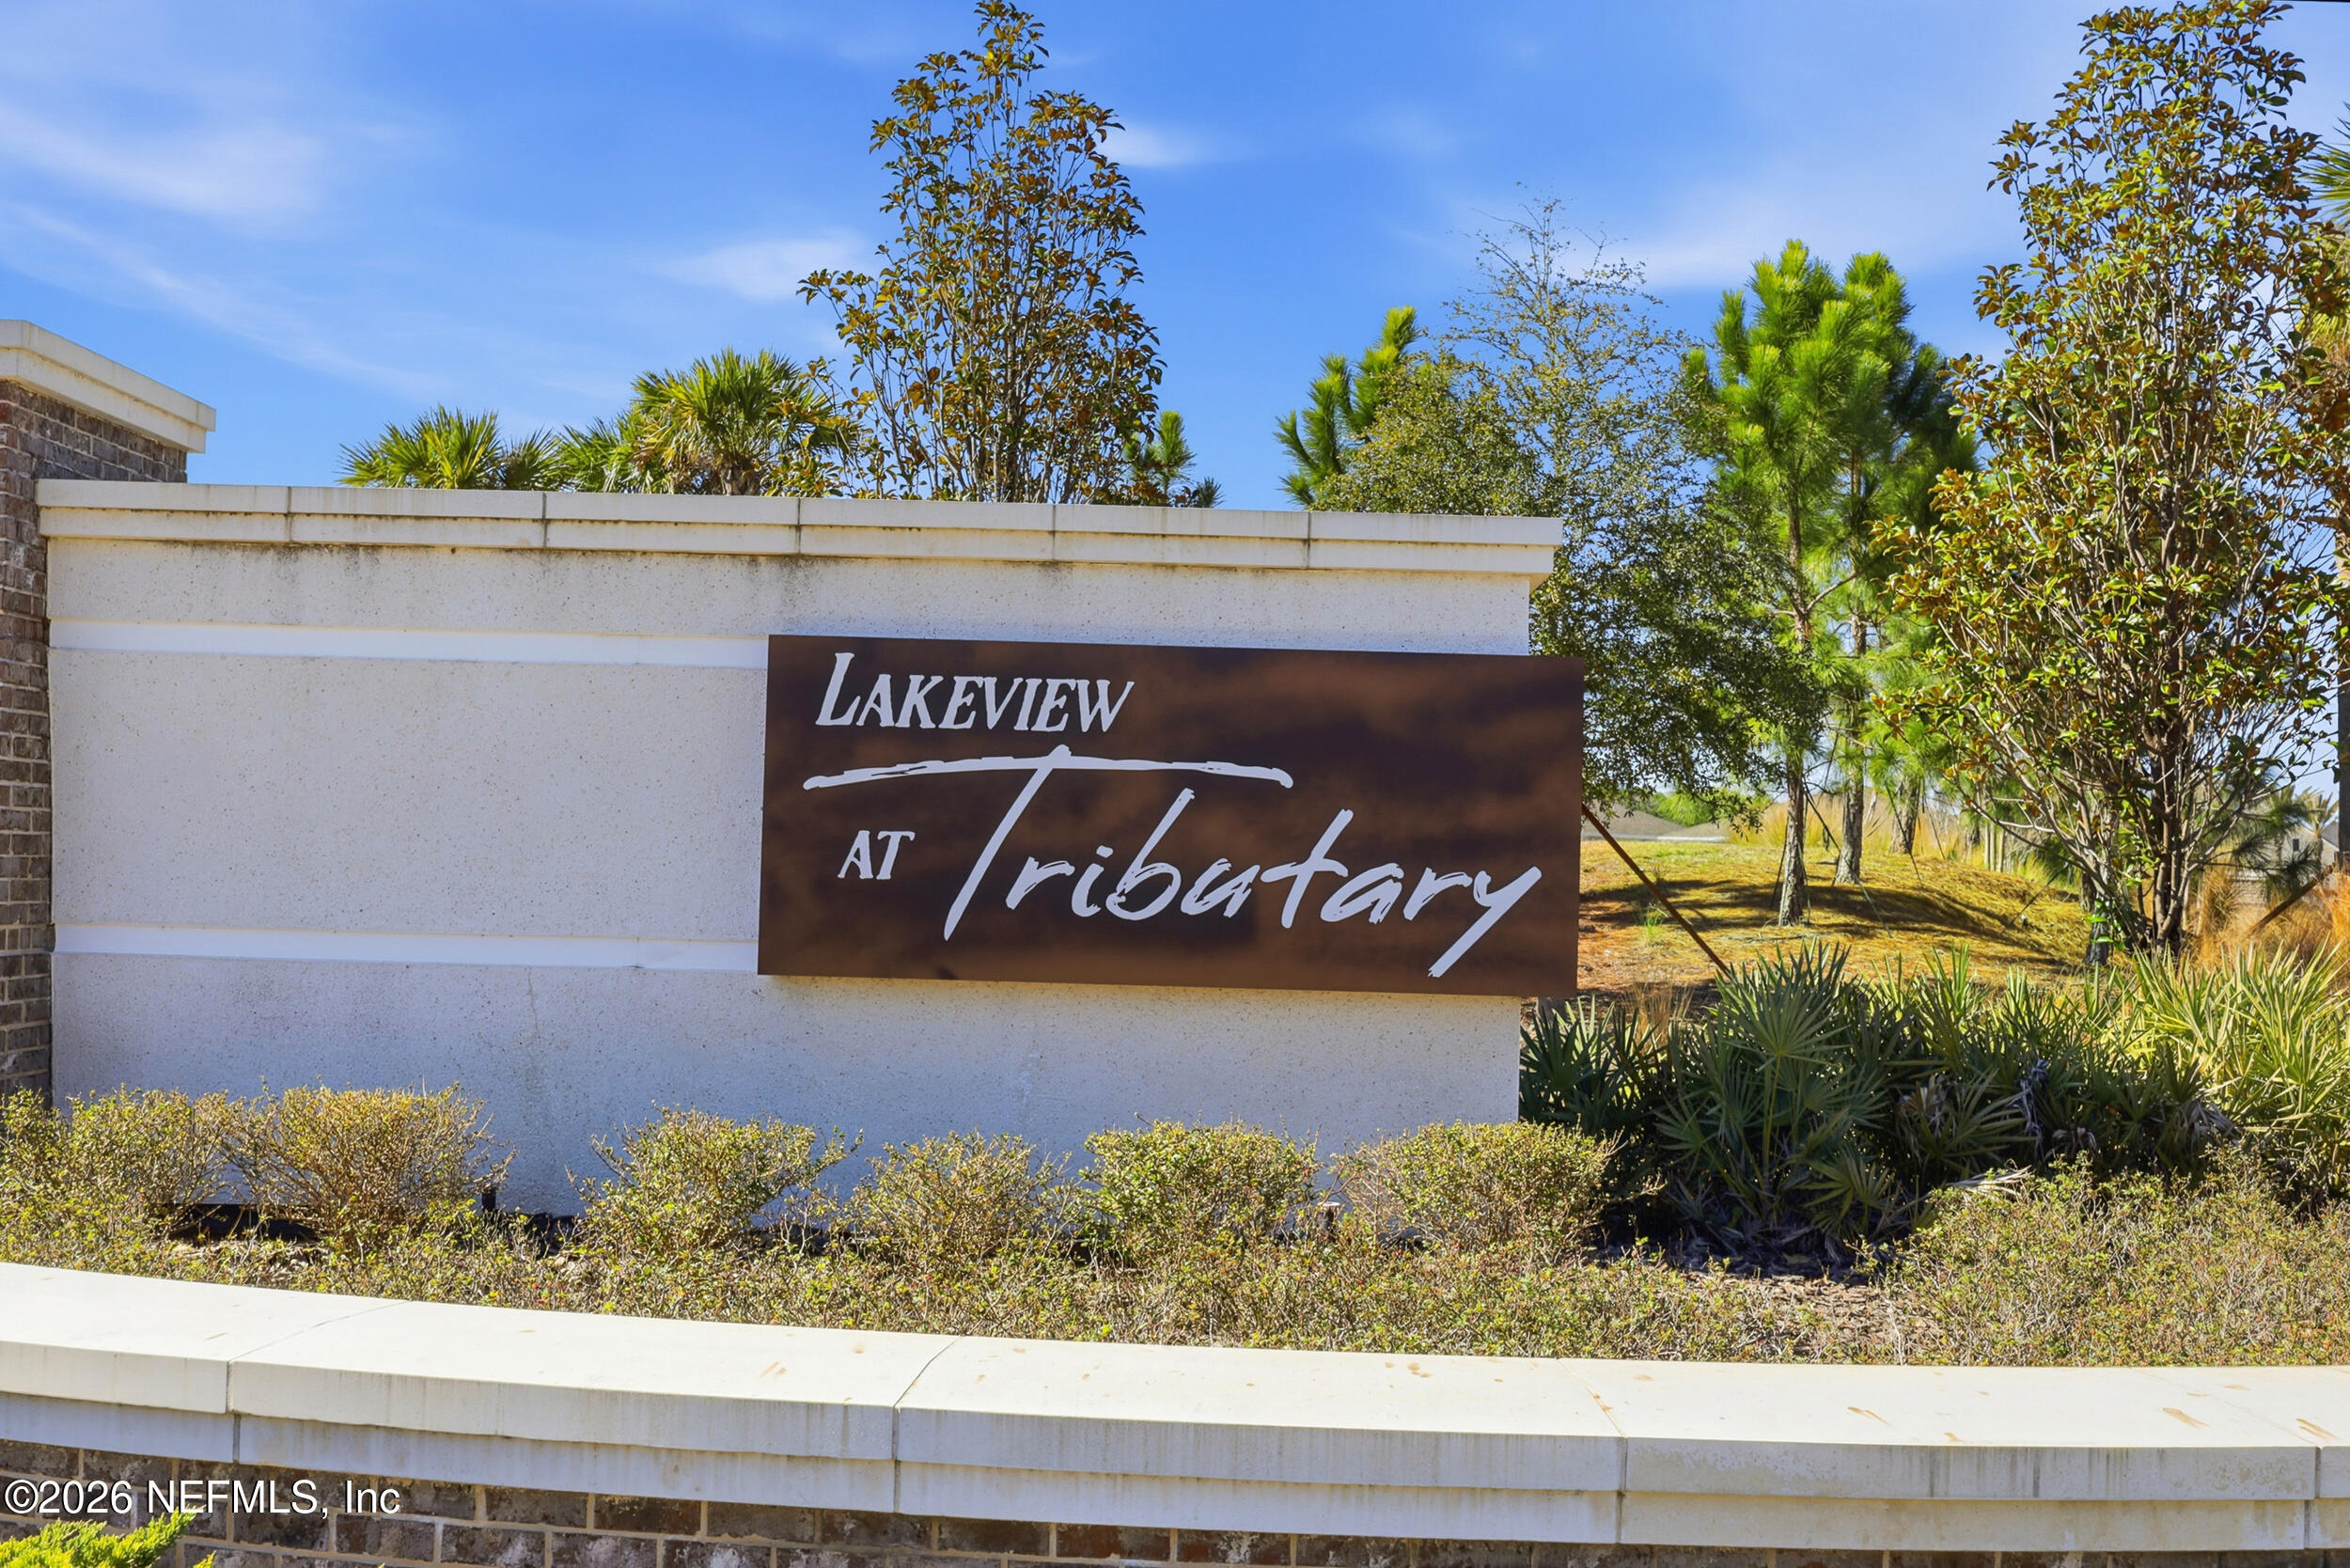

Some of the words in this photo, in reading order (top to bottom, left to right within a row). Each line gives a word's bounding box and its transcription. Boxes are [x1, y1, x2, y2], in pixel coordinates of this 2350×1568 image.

[815, 651, 1135, 732] LAKEVIEW
[803, 744, 1542, 979] Tributary
[838, 830, 916, 881] AT
